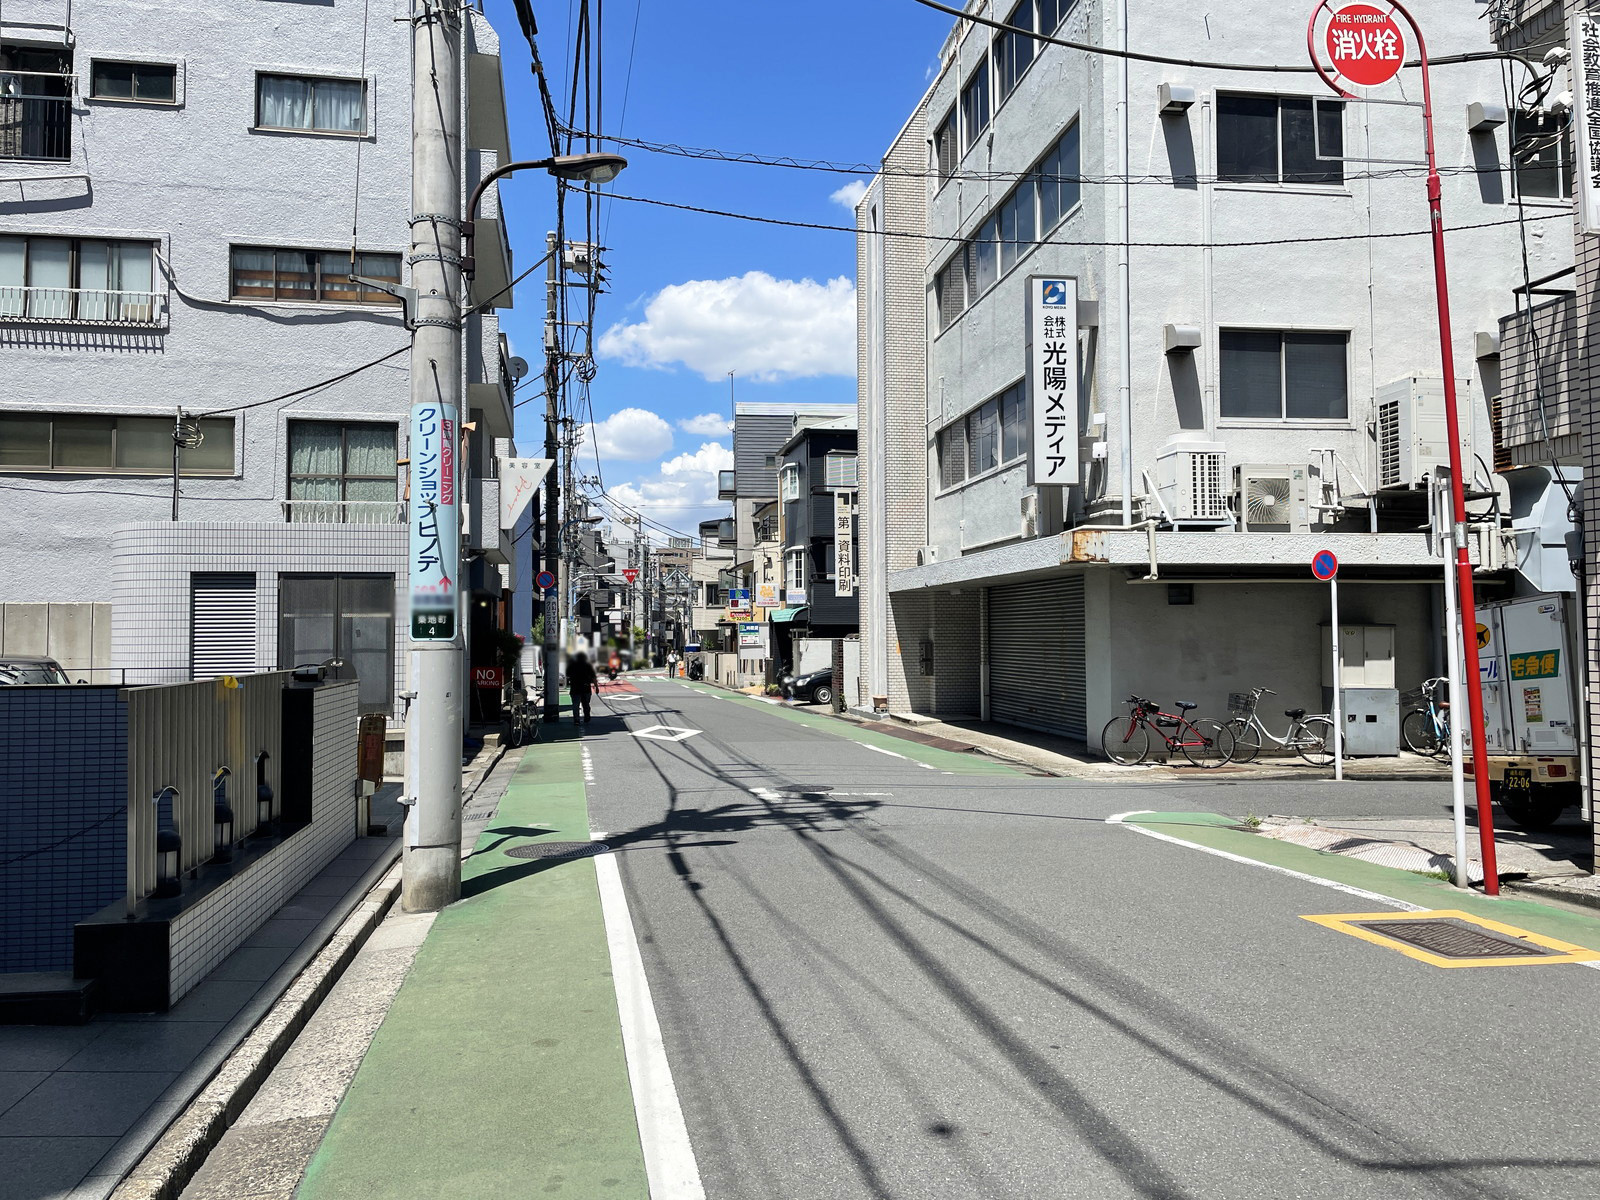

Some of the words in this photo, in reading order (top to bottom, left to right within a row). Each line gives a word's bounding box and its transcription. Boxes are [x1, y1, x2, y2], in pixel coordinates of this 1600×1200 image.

[1335, 14, 1352, 23] FIRE
[1353, 14, 1387, 23] HYDRANT
[1331, 28, 1400, 60] 消火栓
[1043, 340, 1067, 477] 光陽メディア
[509, 462, 541, 470] 美容室
[837, 516, 851, 592] 第一資料印刷
[428, 626, 435, 636] 4
[1479, 660, 1498, 678] ール
[1511, 653, 1555, 677] 宅急便
[476, 669, 495, 680] NO
